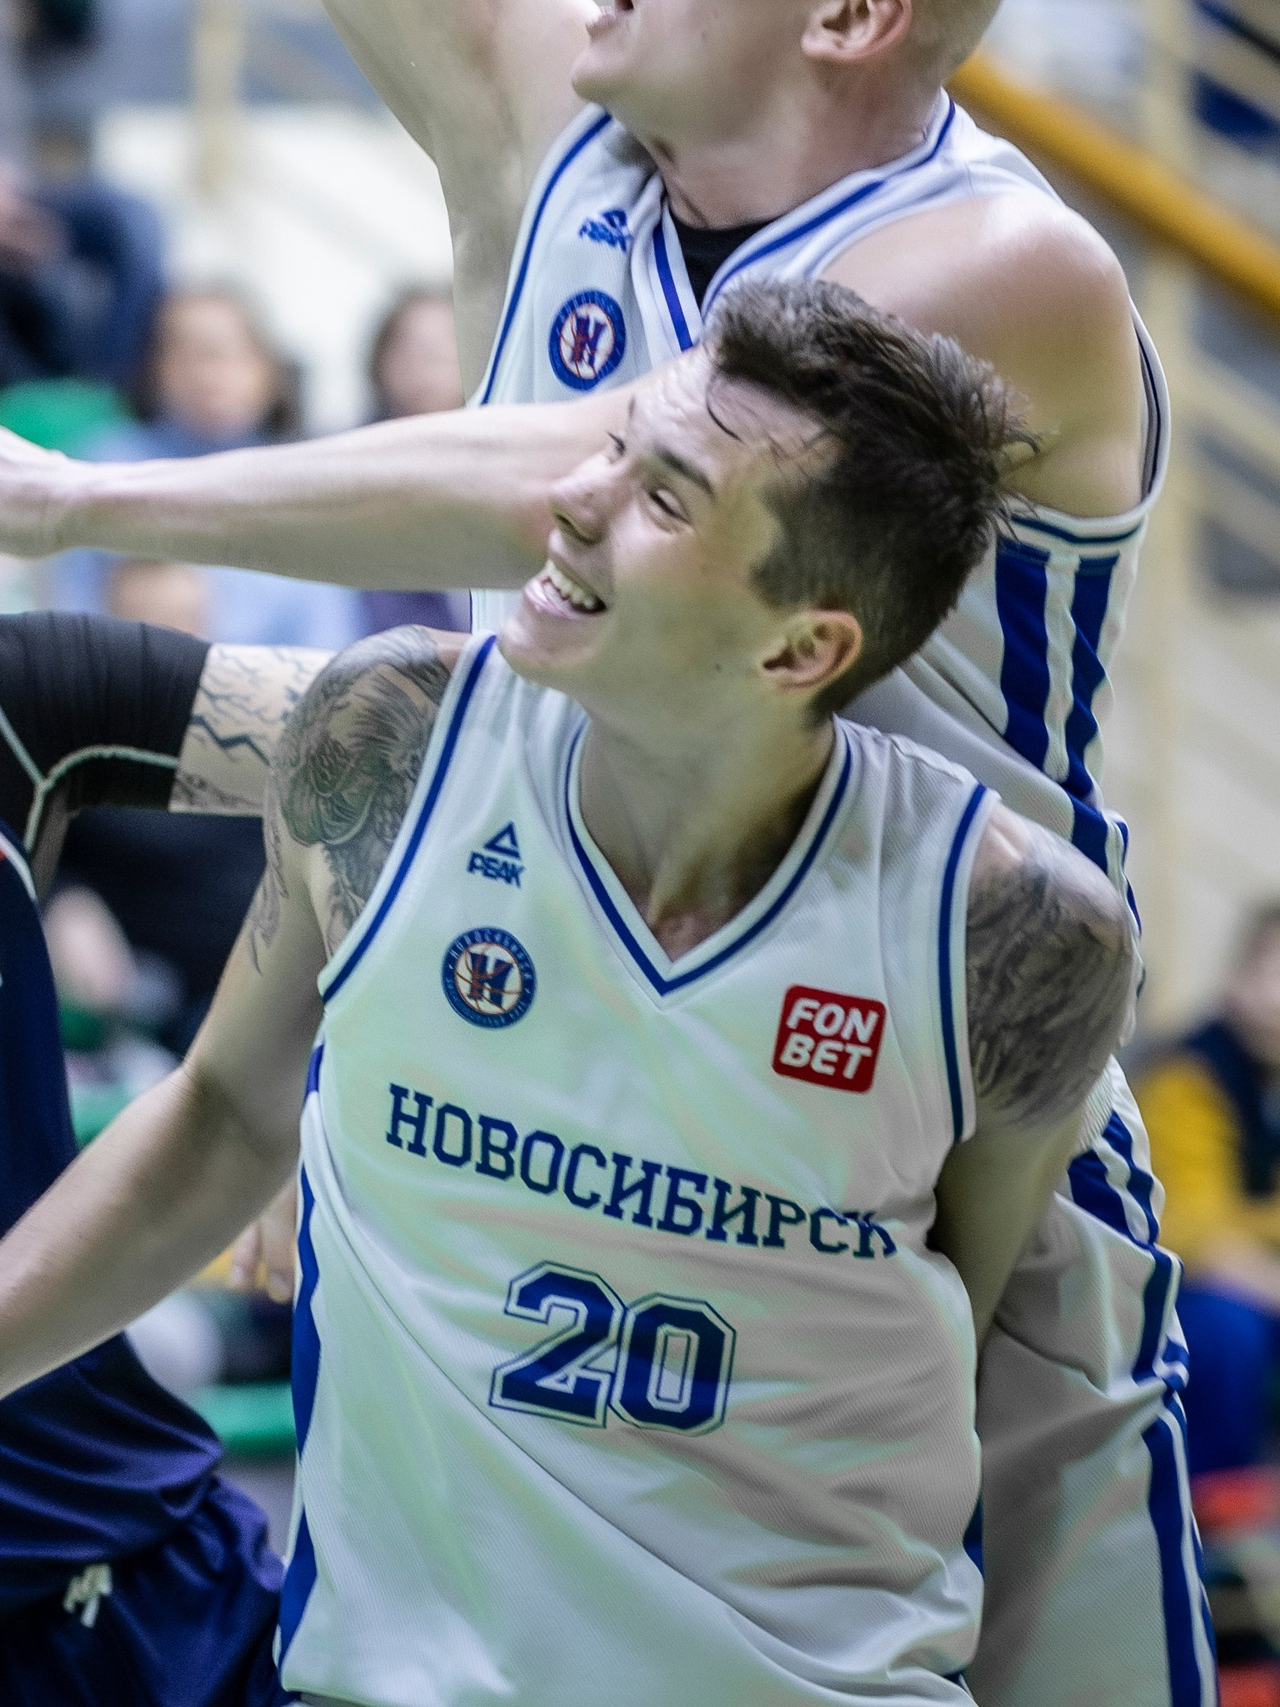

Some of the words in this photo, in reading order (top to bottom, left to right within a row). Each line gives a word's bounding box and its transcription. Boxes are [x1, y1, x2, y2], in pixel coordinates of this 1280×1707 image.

[467, 852, 526, 888] PEAK
[786, 997, 879, 1043] FON
[780, 1032, 873, 1080] BET
[385, 1083, 897, 1260] НОВОСИБИРСК
[488, 1260, 738, 1438] 20
